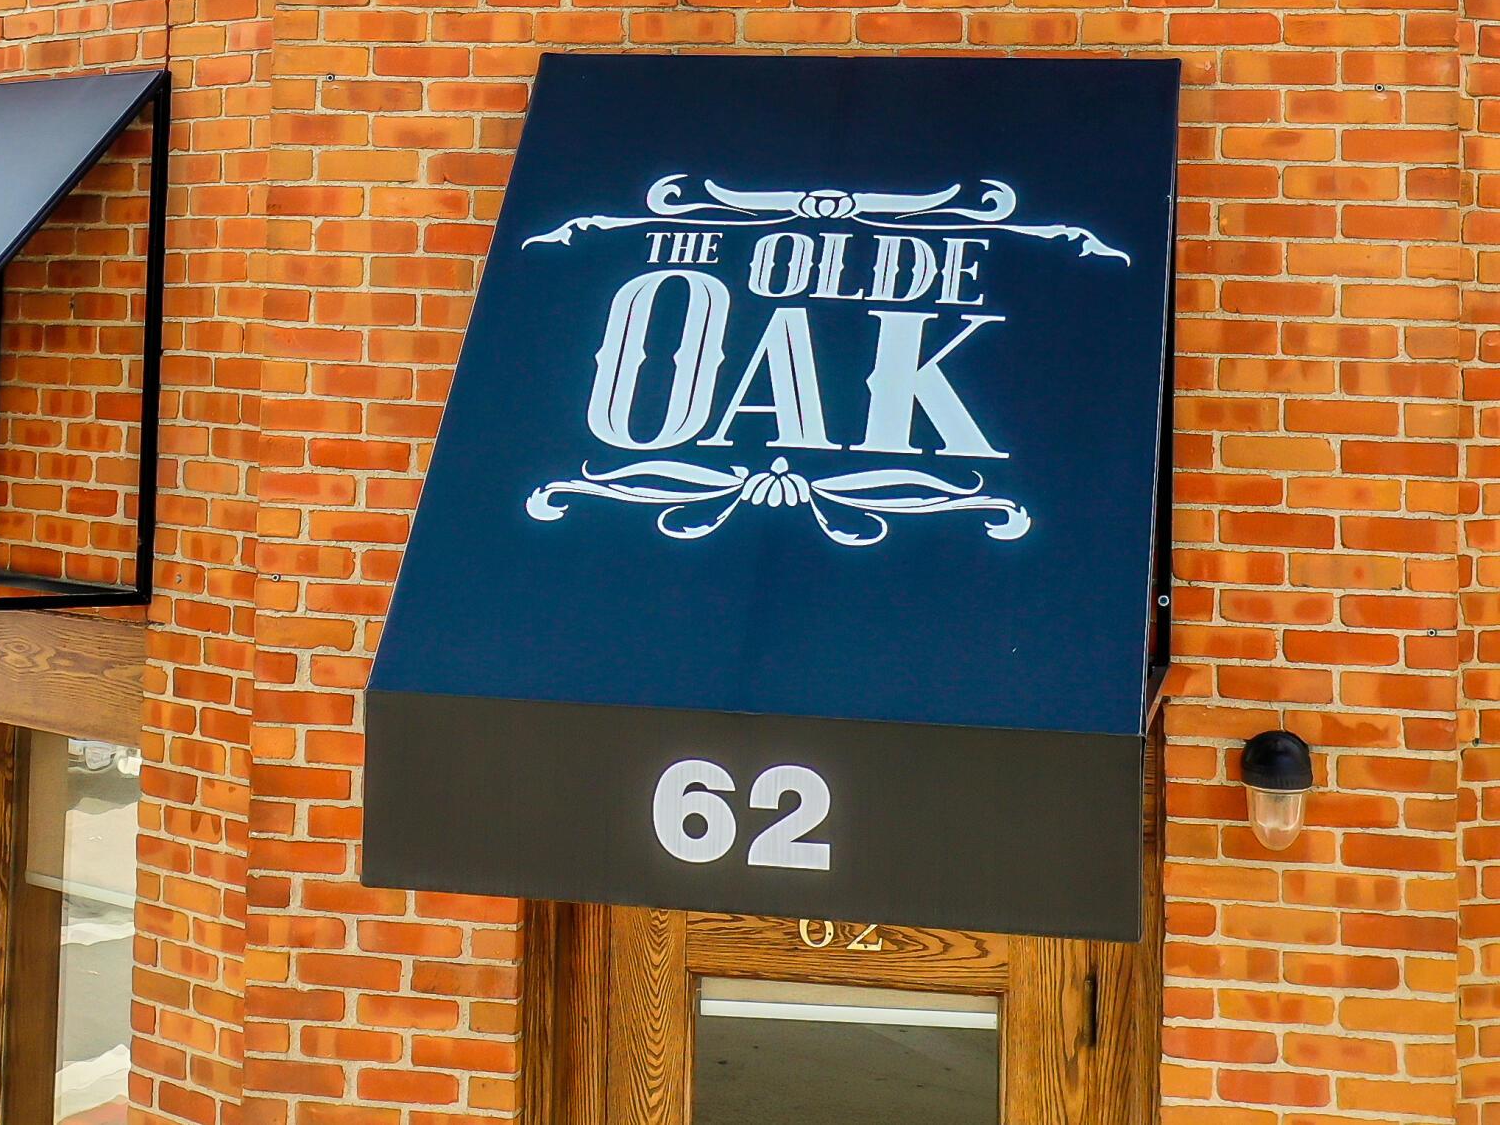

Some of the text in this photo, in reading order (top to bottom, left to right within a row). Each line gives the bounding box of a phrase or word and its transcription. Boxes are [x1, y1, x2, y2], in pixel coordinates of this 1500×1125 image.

[645, 231, 990, 306] THE OLDE
[586, 269, 1010, 459] OAK
[652, 758, 832, 871] 62
